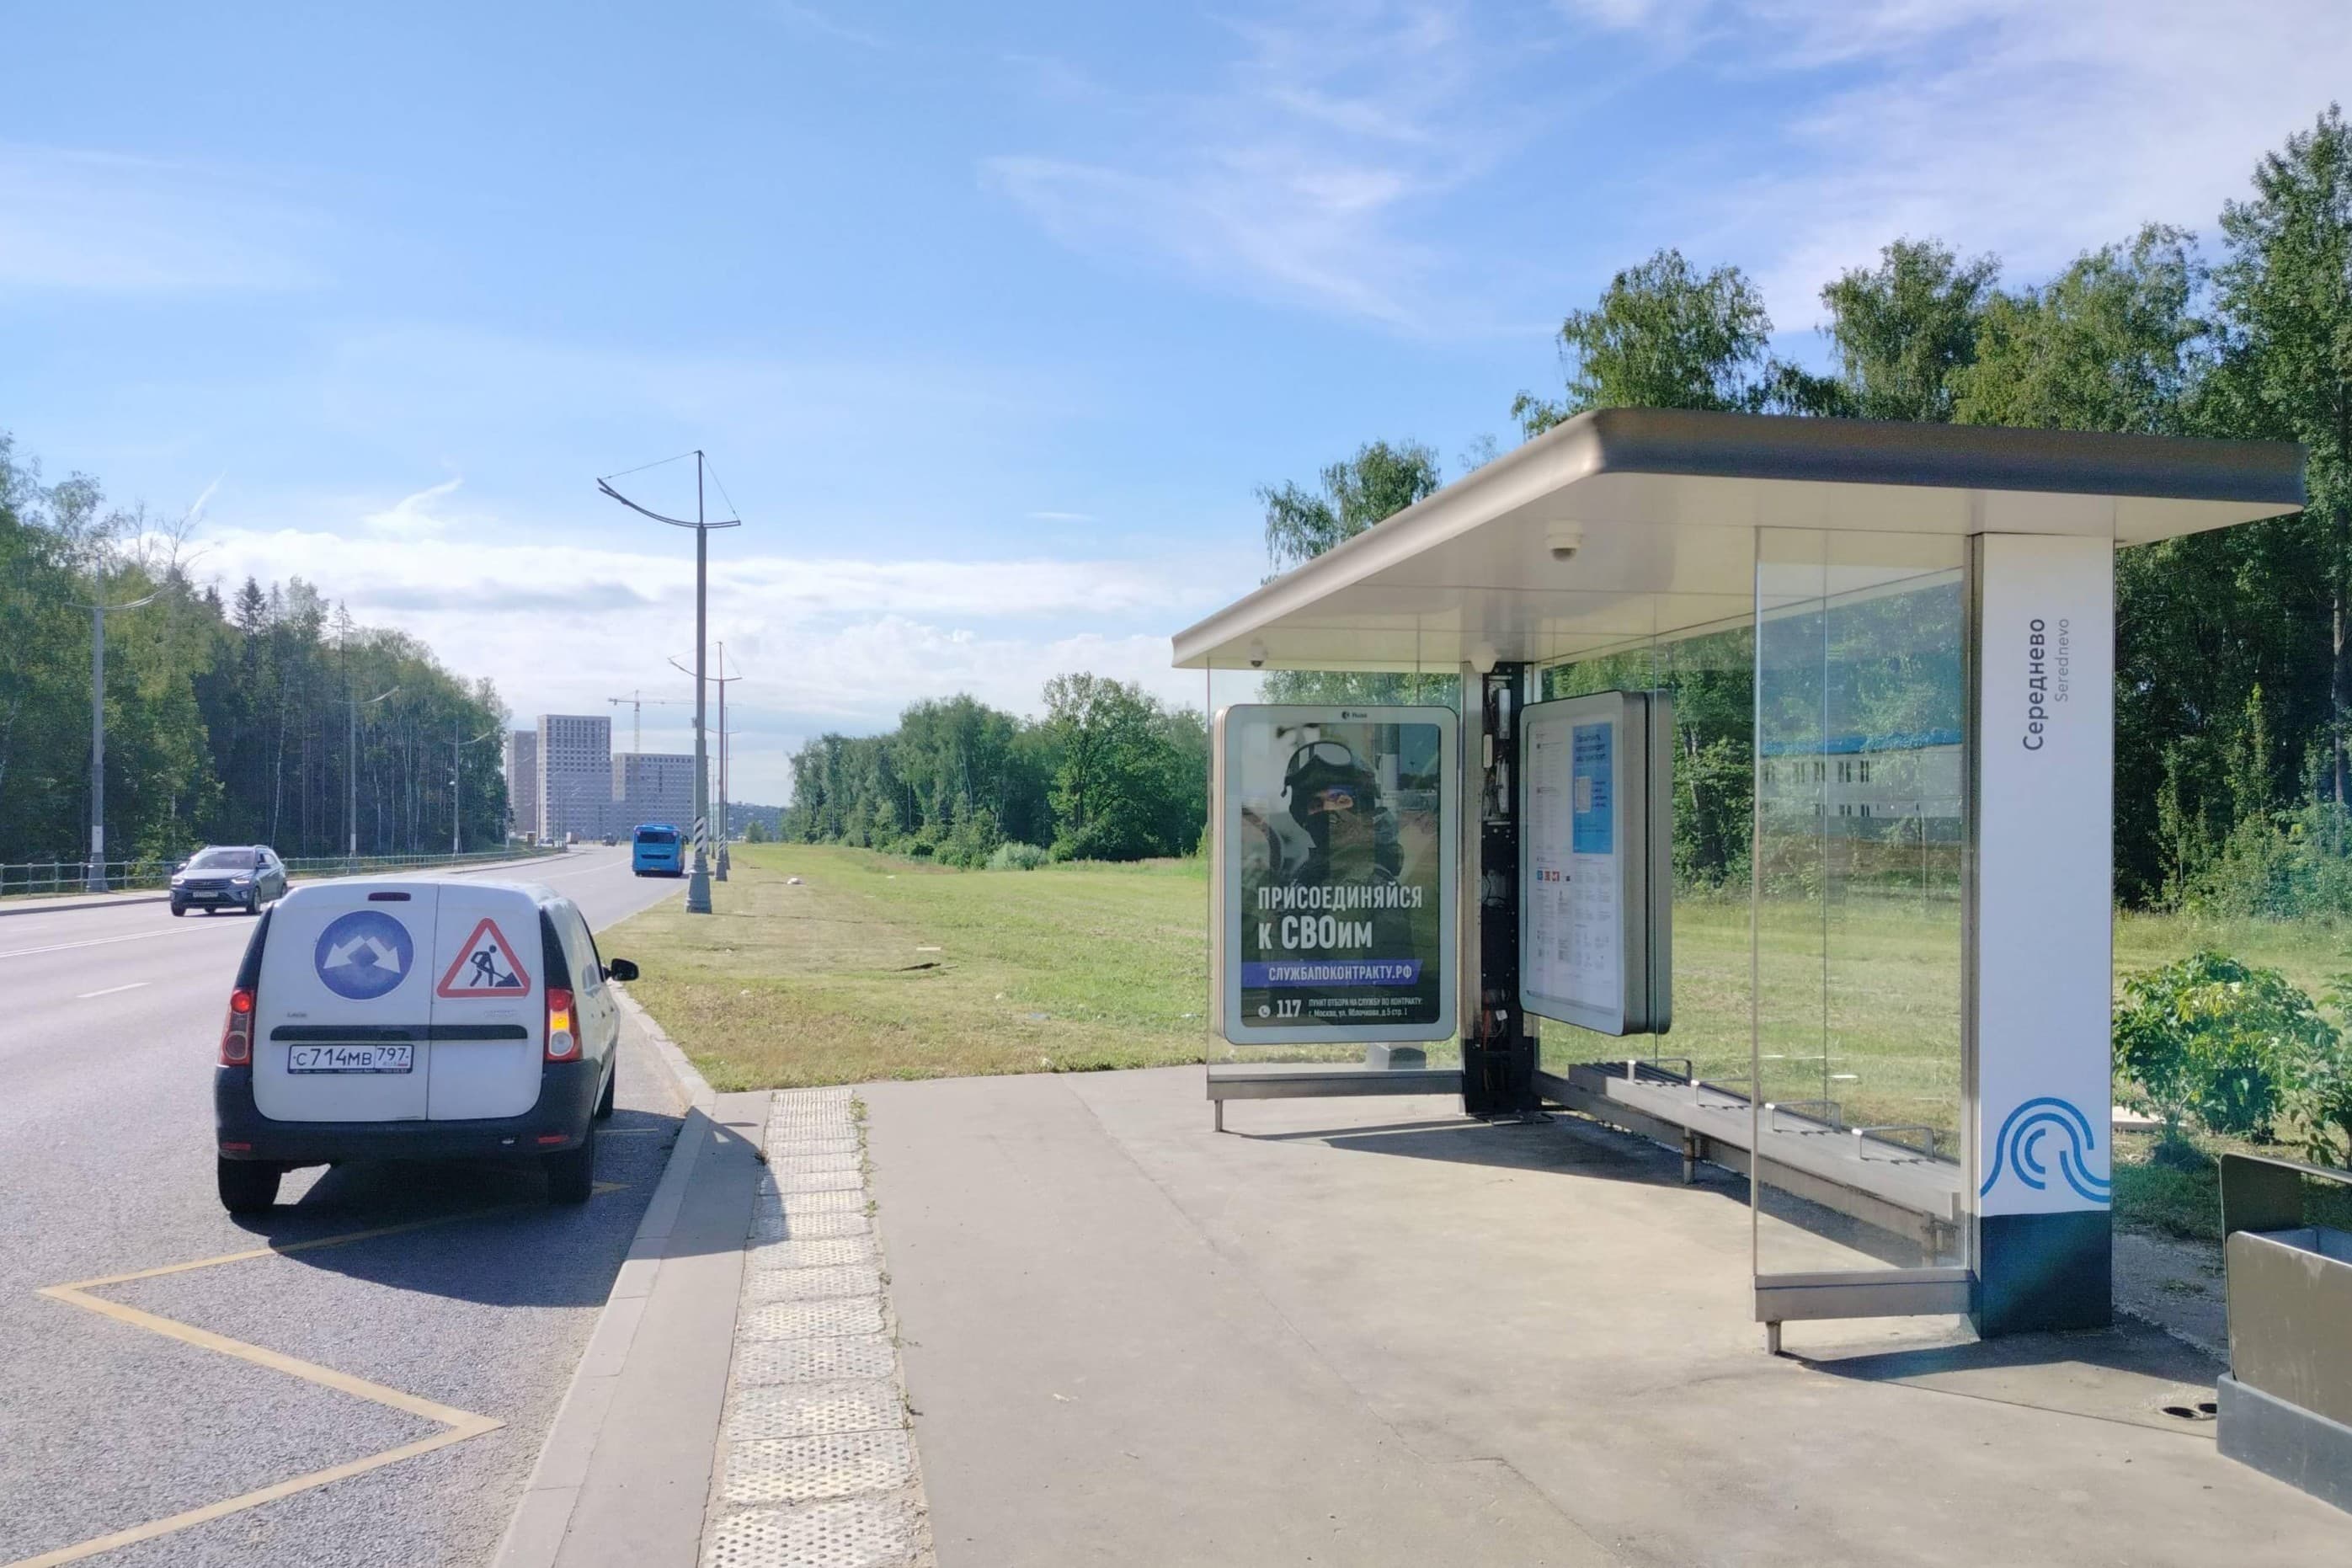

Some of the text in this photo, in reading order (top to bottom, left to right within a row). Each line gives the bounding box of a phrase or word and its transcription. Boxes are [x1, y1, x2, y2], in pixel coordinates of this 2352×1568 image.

[2054, 618, 2070, 702] Serednevo
[2022, 618, 2049, 751] Середнево
[1258, 881, 1423, 912] ПРИСОЕДИНЯЙСЯ
[1268, 965, 1412, 982] СЛУЖБАПОКОНТРАКТУ.РФ
[1276, 999, 1302, 1018] 117
[377, 1048, 407, 1061] 797
